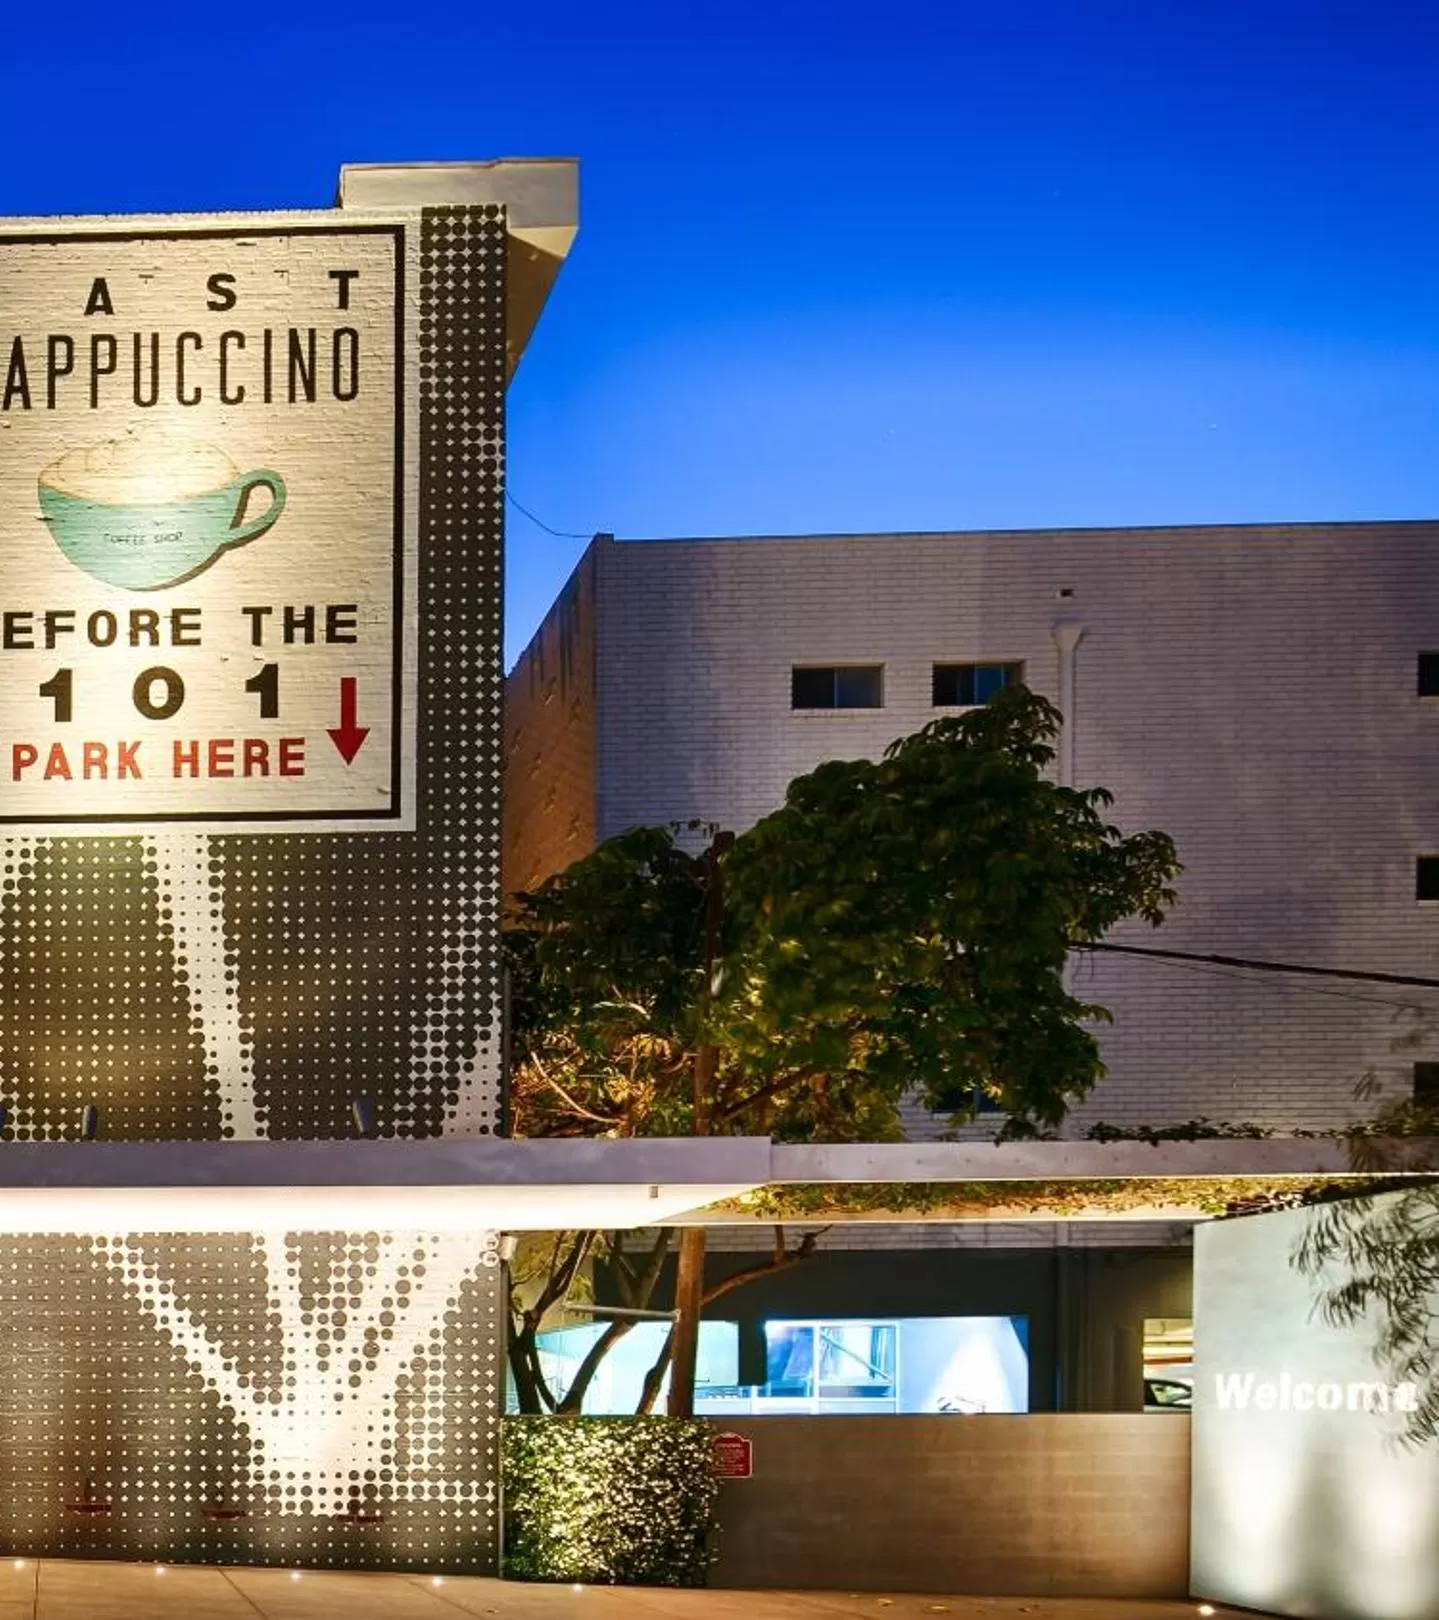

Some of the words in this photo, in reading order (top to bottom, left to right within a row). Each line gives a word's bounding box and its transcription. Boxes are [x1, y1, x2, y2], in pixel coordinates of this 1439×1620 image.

[242, 604, 359, 644] THE
[12, 740, 143, 782] PARK
[173, 737, 305, 778] HERE
[1215, 1371, 1419, 1412] Welcome
